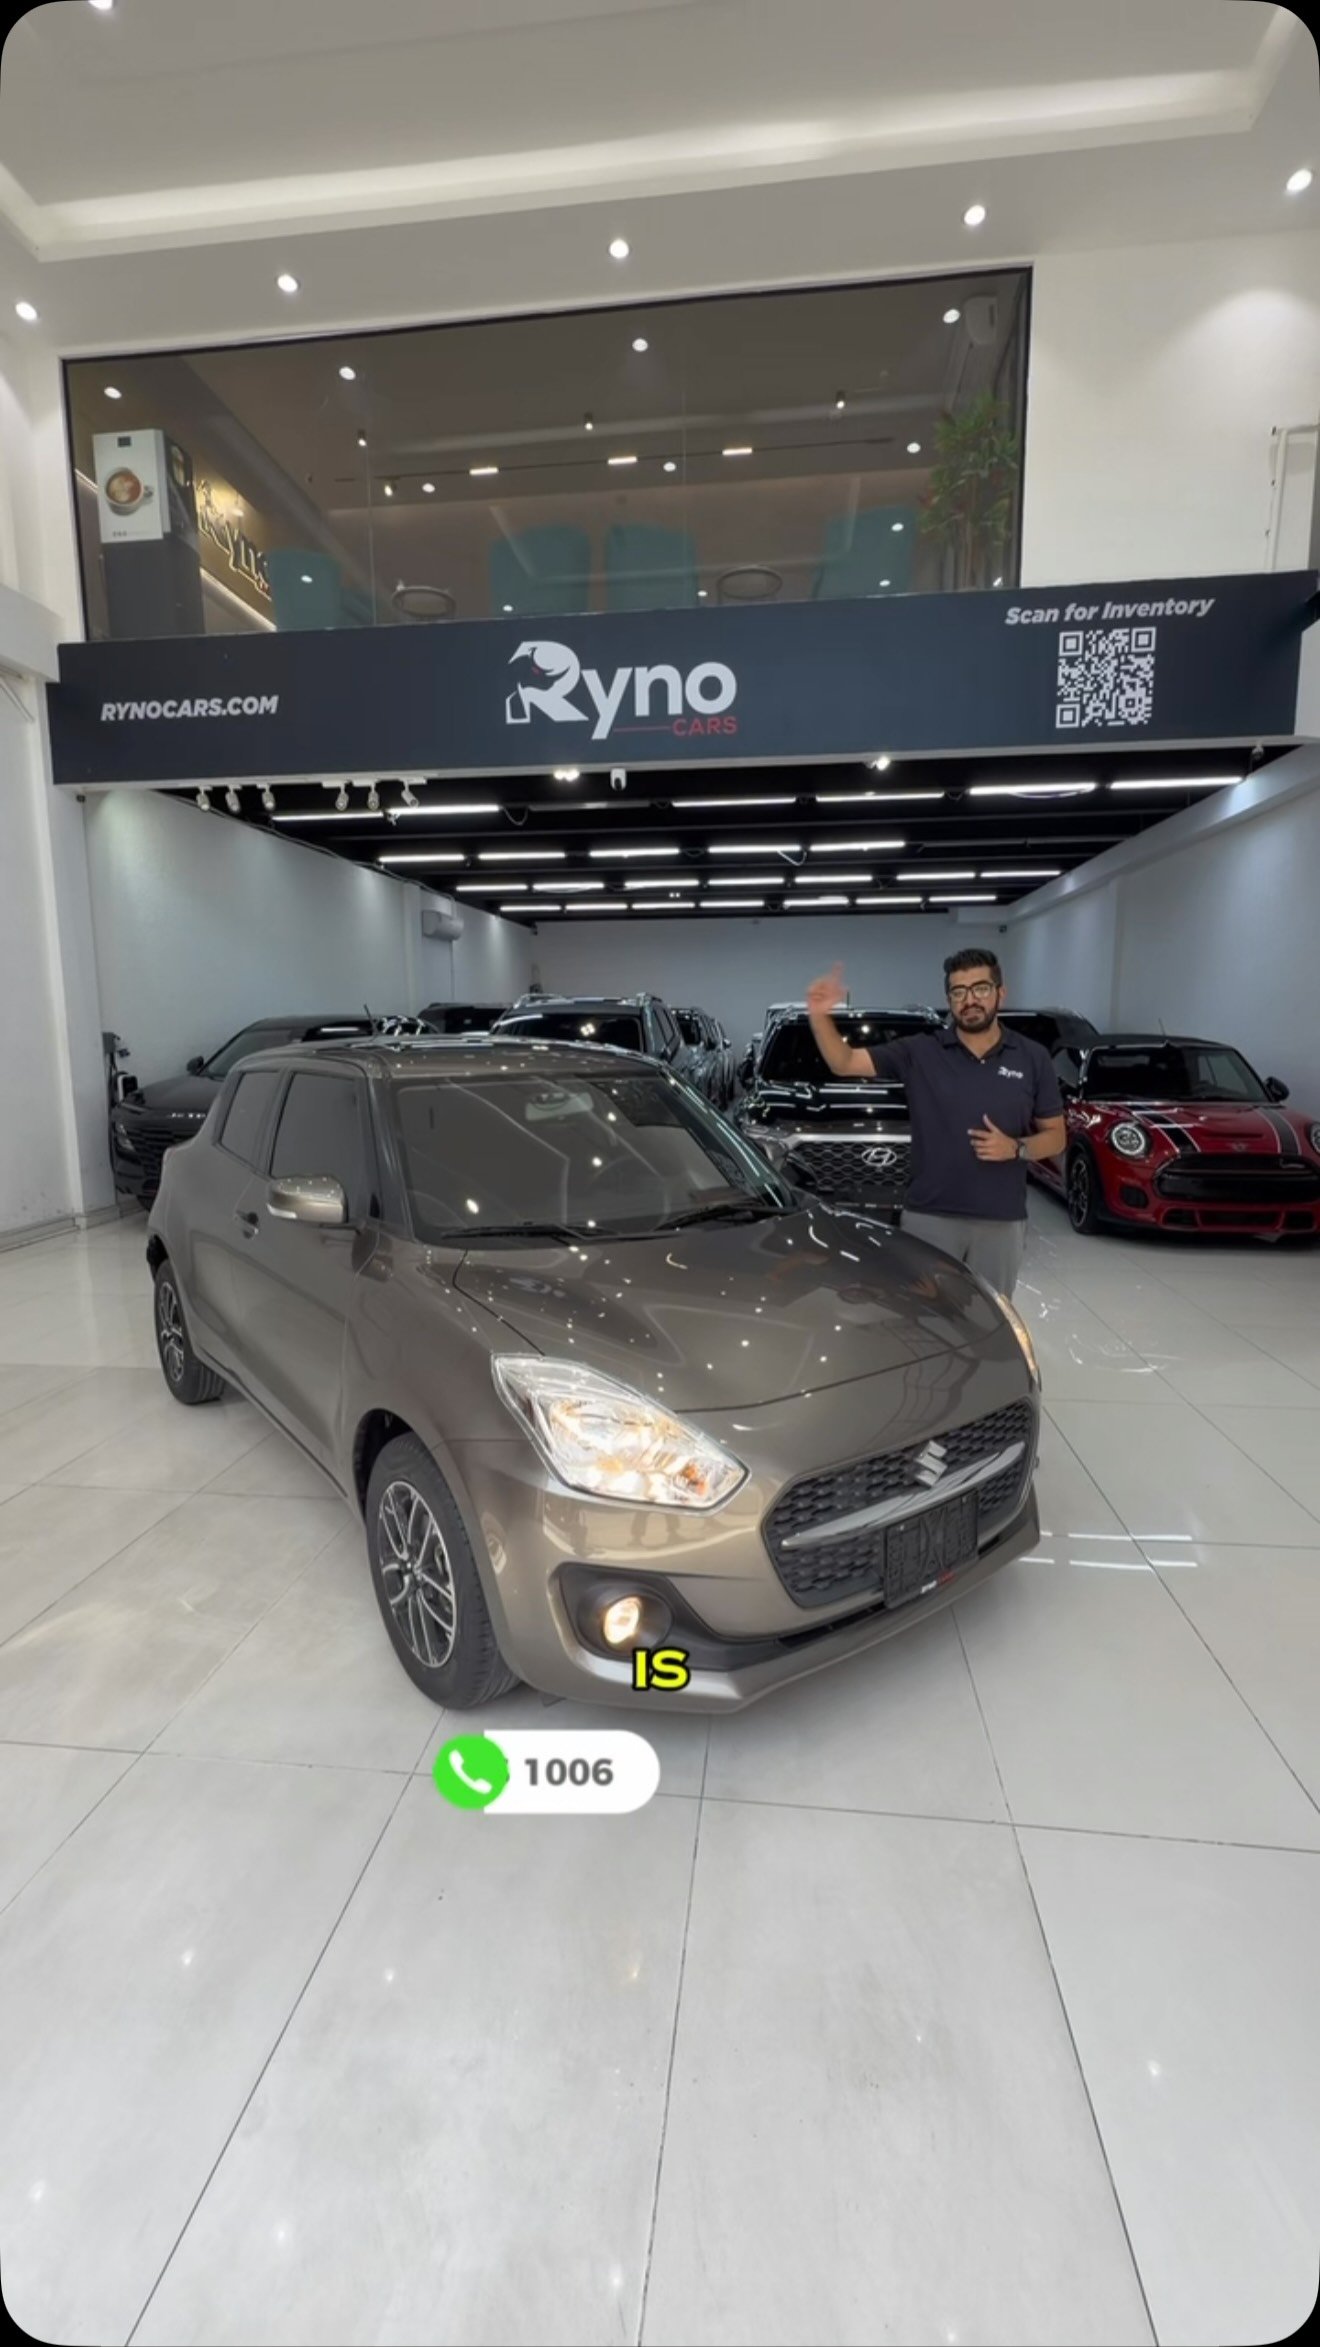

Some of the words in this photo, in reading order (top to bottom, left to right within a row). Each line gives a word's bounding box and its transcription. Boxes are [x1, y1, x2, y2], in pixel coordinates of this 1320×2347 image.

[1005, 607, 1060, 625] Scan
[1064, 603, 1099, 622] for
[1101, 598, 1215, 620] Inventory
[506, 641, 737, 740] Ryno
[101, 696, 279, 721] RYNOCARS.COM
[672, 716, 738, 736] CARS
